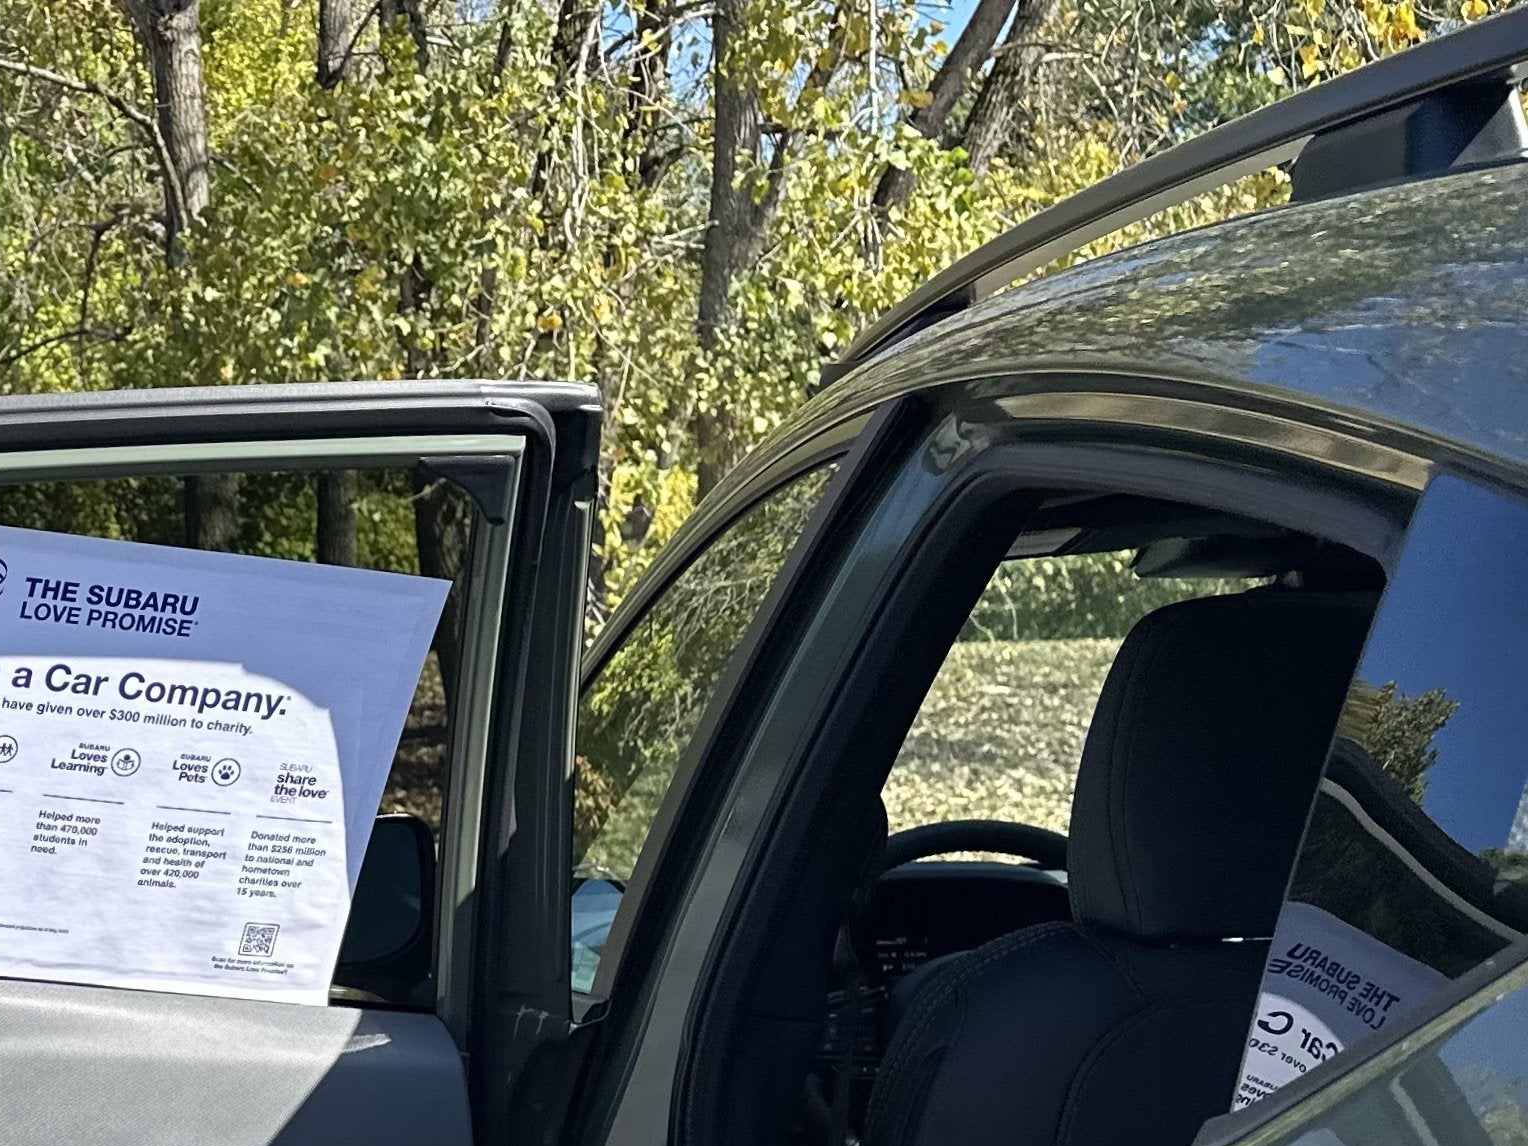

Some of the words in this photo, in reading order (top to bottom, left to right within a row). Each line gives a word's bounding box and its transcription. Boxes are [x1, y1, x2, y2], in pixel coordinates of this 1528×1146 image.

[25, 577, 80, 602] THE
[86, 584, 200, 616] SUBARU
[19, 601, 81, 625] LOVE
[86, 609, 194, 637] PROMISE
[11, 667, 33, 688] a
[45, 664, 109, 696] Car
[118, 672, 287, 721] Company.
[2, 697, 33, 712] have
[36, 703, 73, 716] given
[76, 707, 106, 719] over
[109, 709, 141, 723] $300
[143, 713, 187, 728] million
[190, 717, 204, 730] to
[206, 719, 253, 736] charity.
[71, 749, 108, 763] Loves
[51, 758, 105, 776] Learning
[172, 760, 208, 773] Loves
[179, 771, 206, 783] Pets
[277, 772, 317, 785] share
[274, 784, 297, 796] the
[298, 786, 327, 798] love
[39, 810, 73, 822] Helped
[76, 815, 101, 824] more
[36, 822, 58, 831] than
[152, 822, 185, 833] Helped
[187, 825, 224, 837] support
[33, 834, 76, 845] students
[79, 837, 88, 846] in
[149, 834, 163, 842] the
[251, 831, 290, 842] Donated
[292, 835, 316, 844] more
[183, 848, 226, 859] transport
[248, 843, 268, 852] than
[295, 847, 326, 856] million
[143, 856, 161, 864] and
[163, 857, 192, 867] health
[195, 860, 205, 868] of
[257, 856, 294, 865] national
[242, 865, 290, 876] hometown
[239, 876, 278, 886] charities
[237, 887, 247, 895] 15
